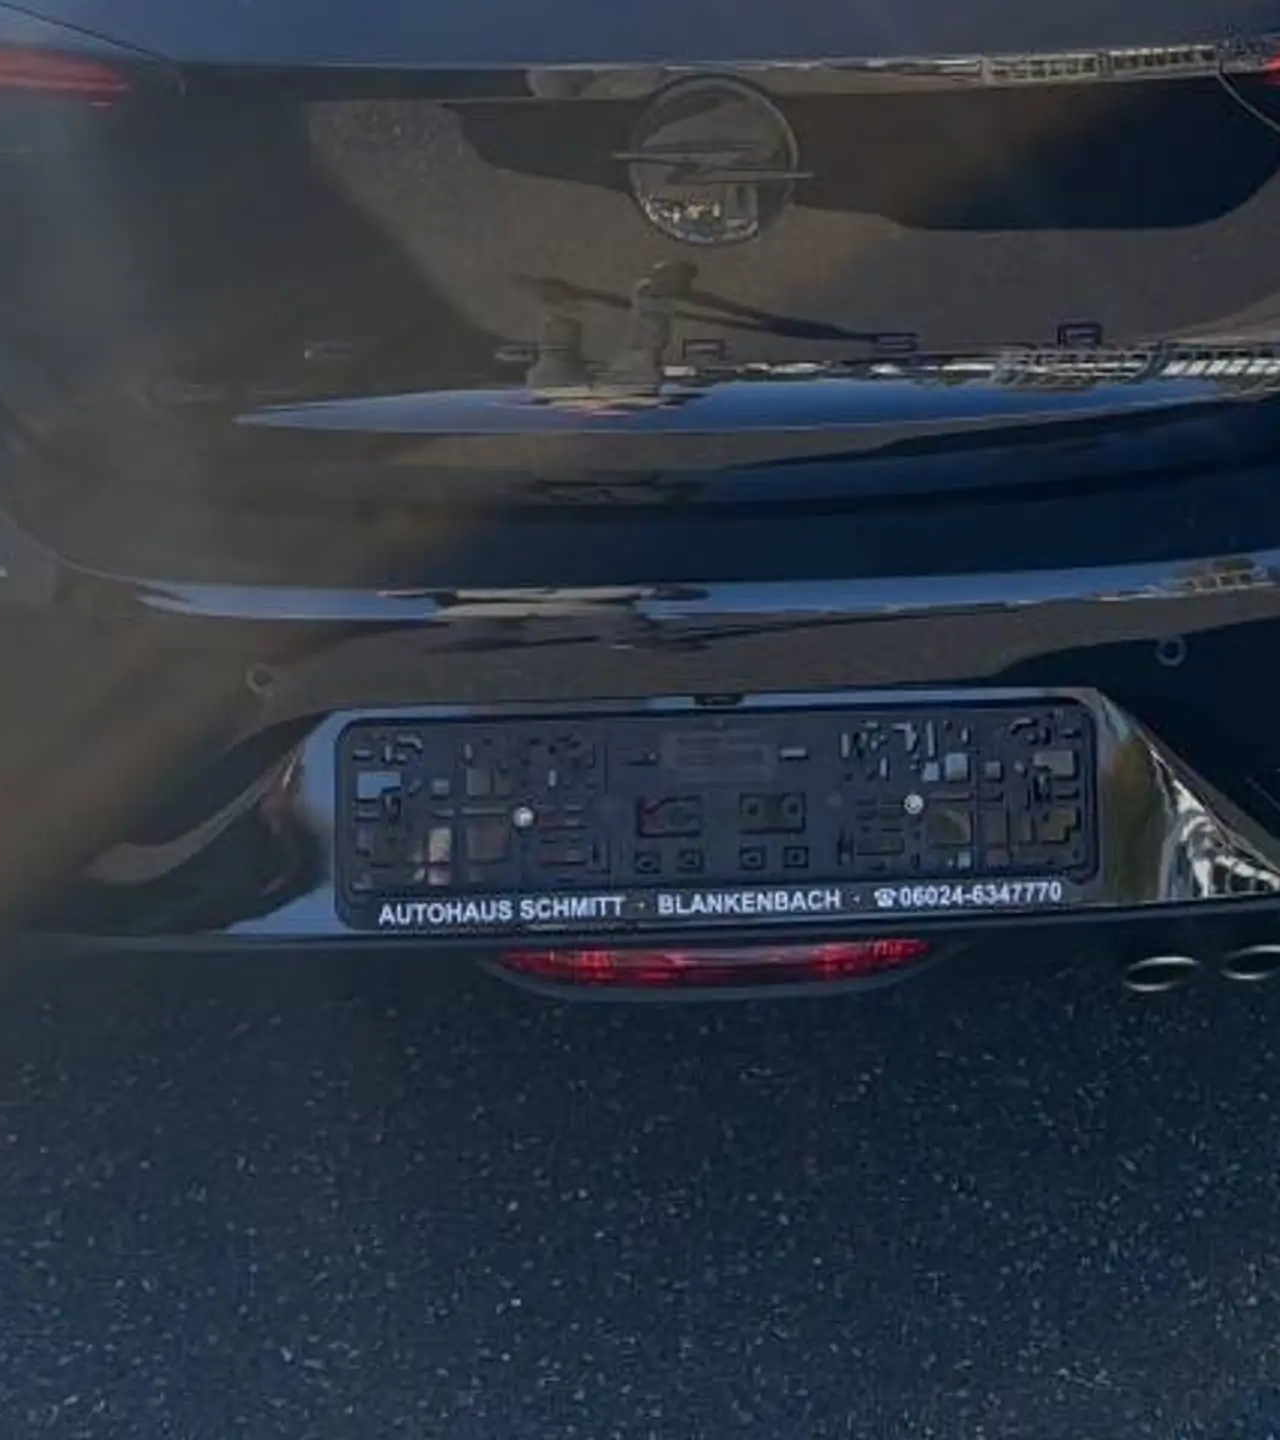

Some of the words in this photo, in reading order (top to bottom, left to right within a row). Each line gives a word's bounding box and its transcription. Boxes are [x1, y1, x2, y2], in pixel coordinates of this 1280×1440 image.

[378, 898, 513, 925] AUTOHAUS
[520, 895, 626, 921] SCHMITT
[657, 889, 841, 915] BLANKENBACH
[898, 881, 1063, 907] 06024-6347770
